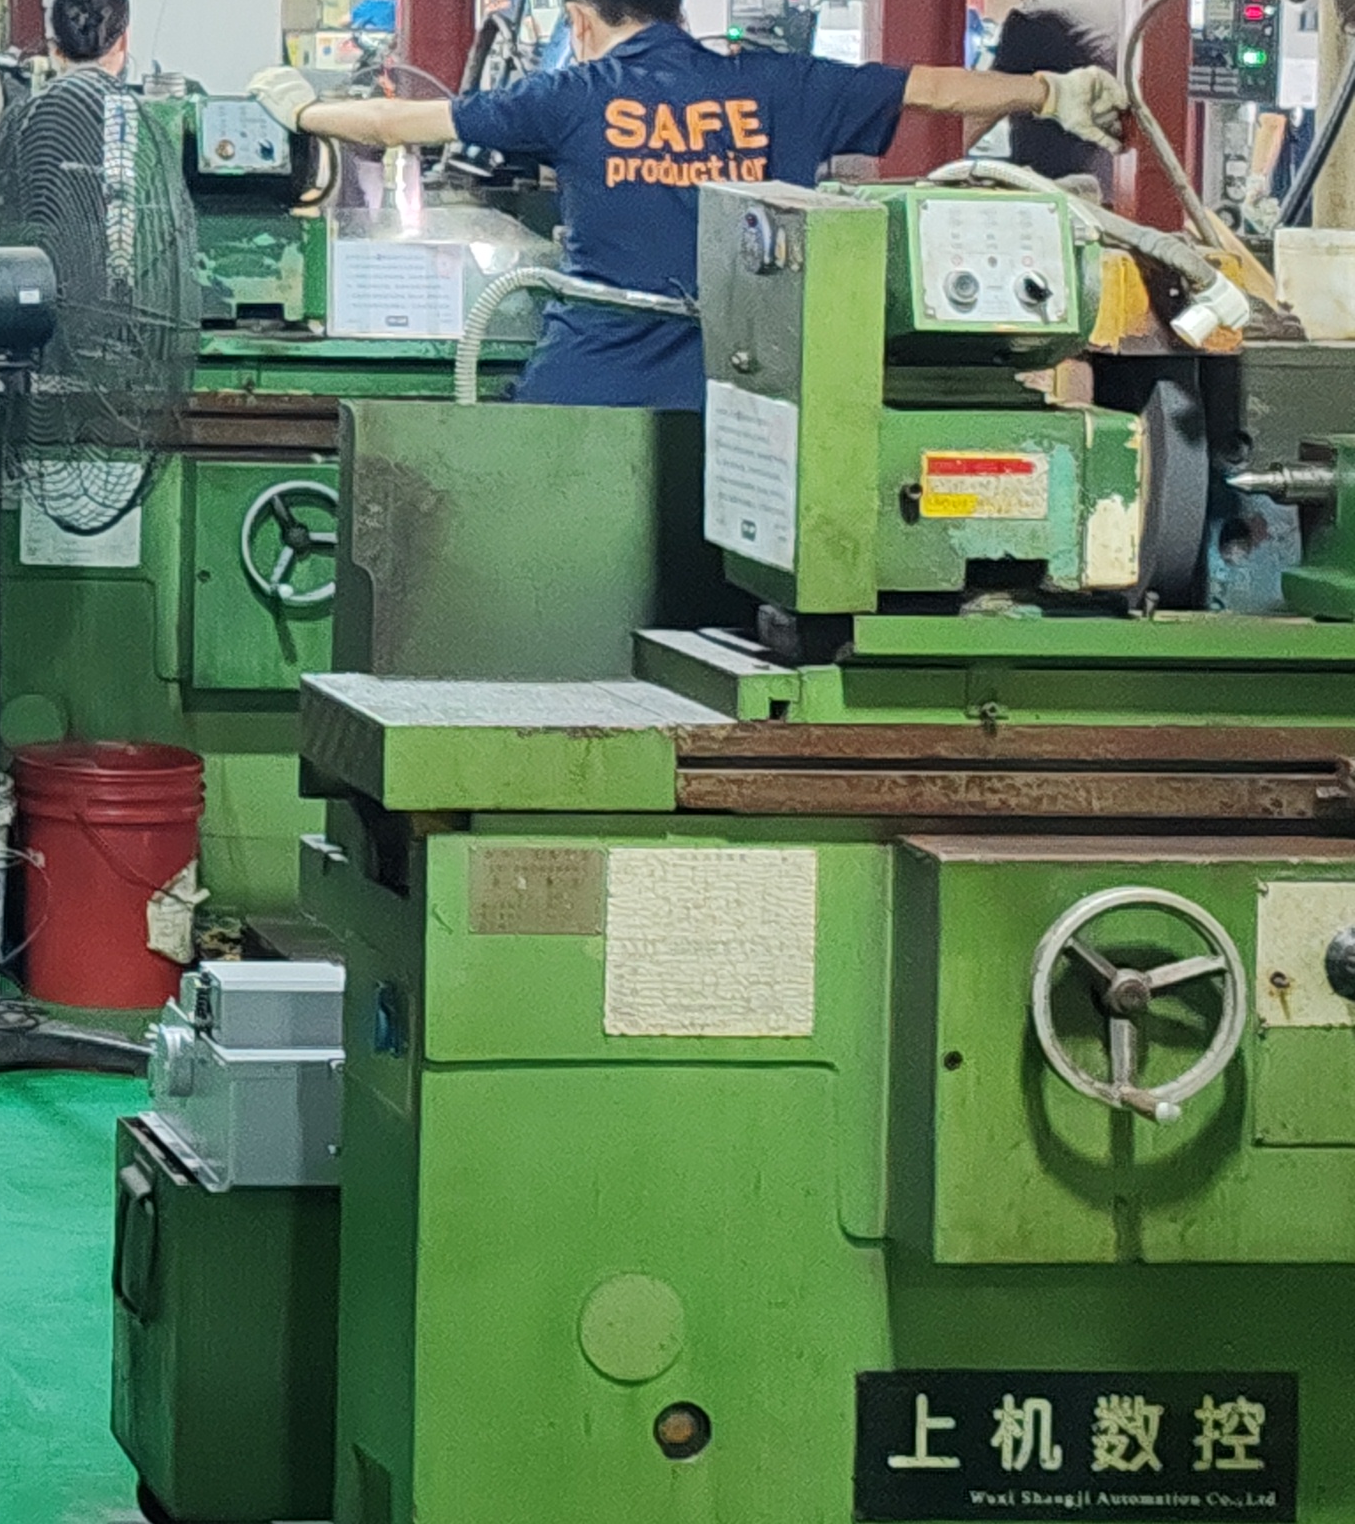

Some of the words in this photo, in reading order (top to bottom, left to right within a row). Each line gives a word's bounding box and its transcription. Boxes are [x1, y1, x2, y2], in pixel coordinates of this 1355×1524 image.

[604, 98, 770, 152] SAFE
[887, 1392, 1267, 1473] 上机数控
[1021, 1489, 1092, 1509] Shangji
[1097, 1490, 1201, 1507] Automation
